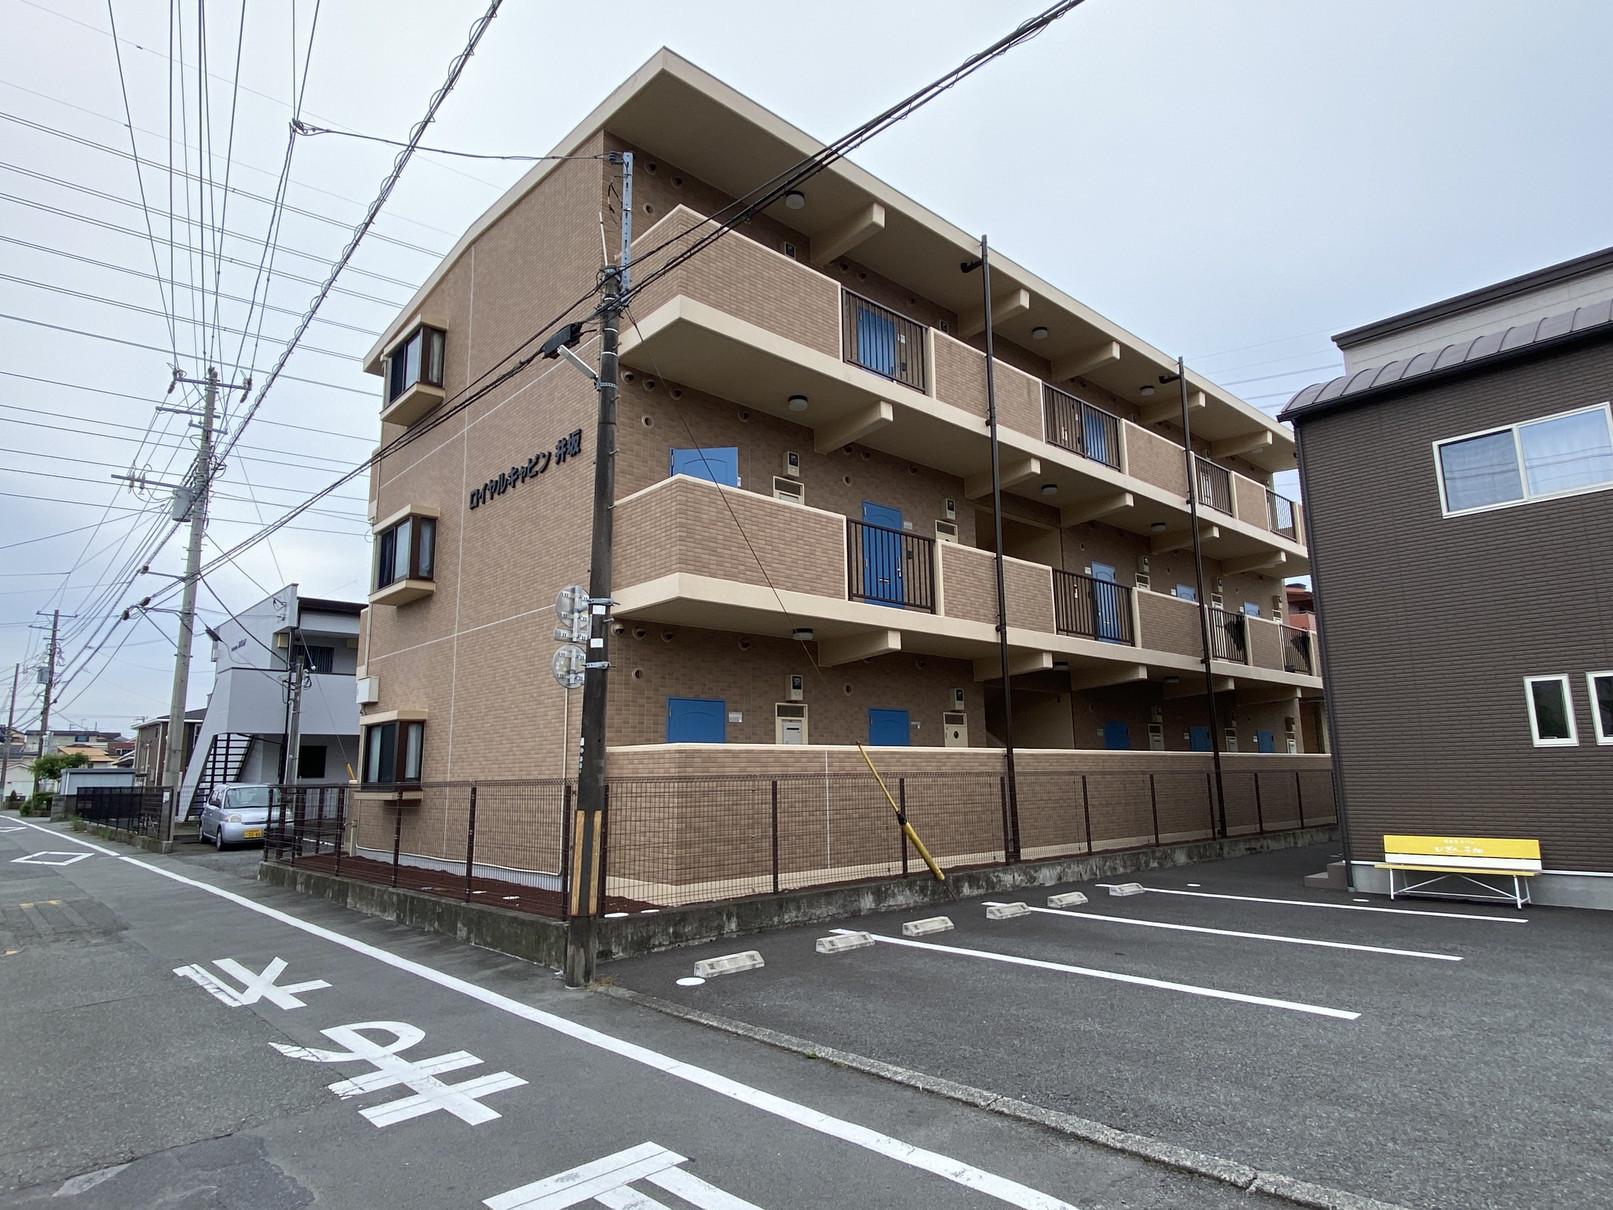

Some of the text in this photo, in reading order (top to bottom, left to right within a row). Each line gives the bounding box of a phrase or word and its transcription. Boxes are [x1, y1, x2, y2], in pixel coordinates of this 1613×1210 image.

[469, 452, 552, 511] ロイヤルキャビン
